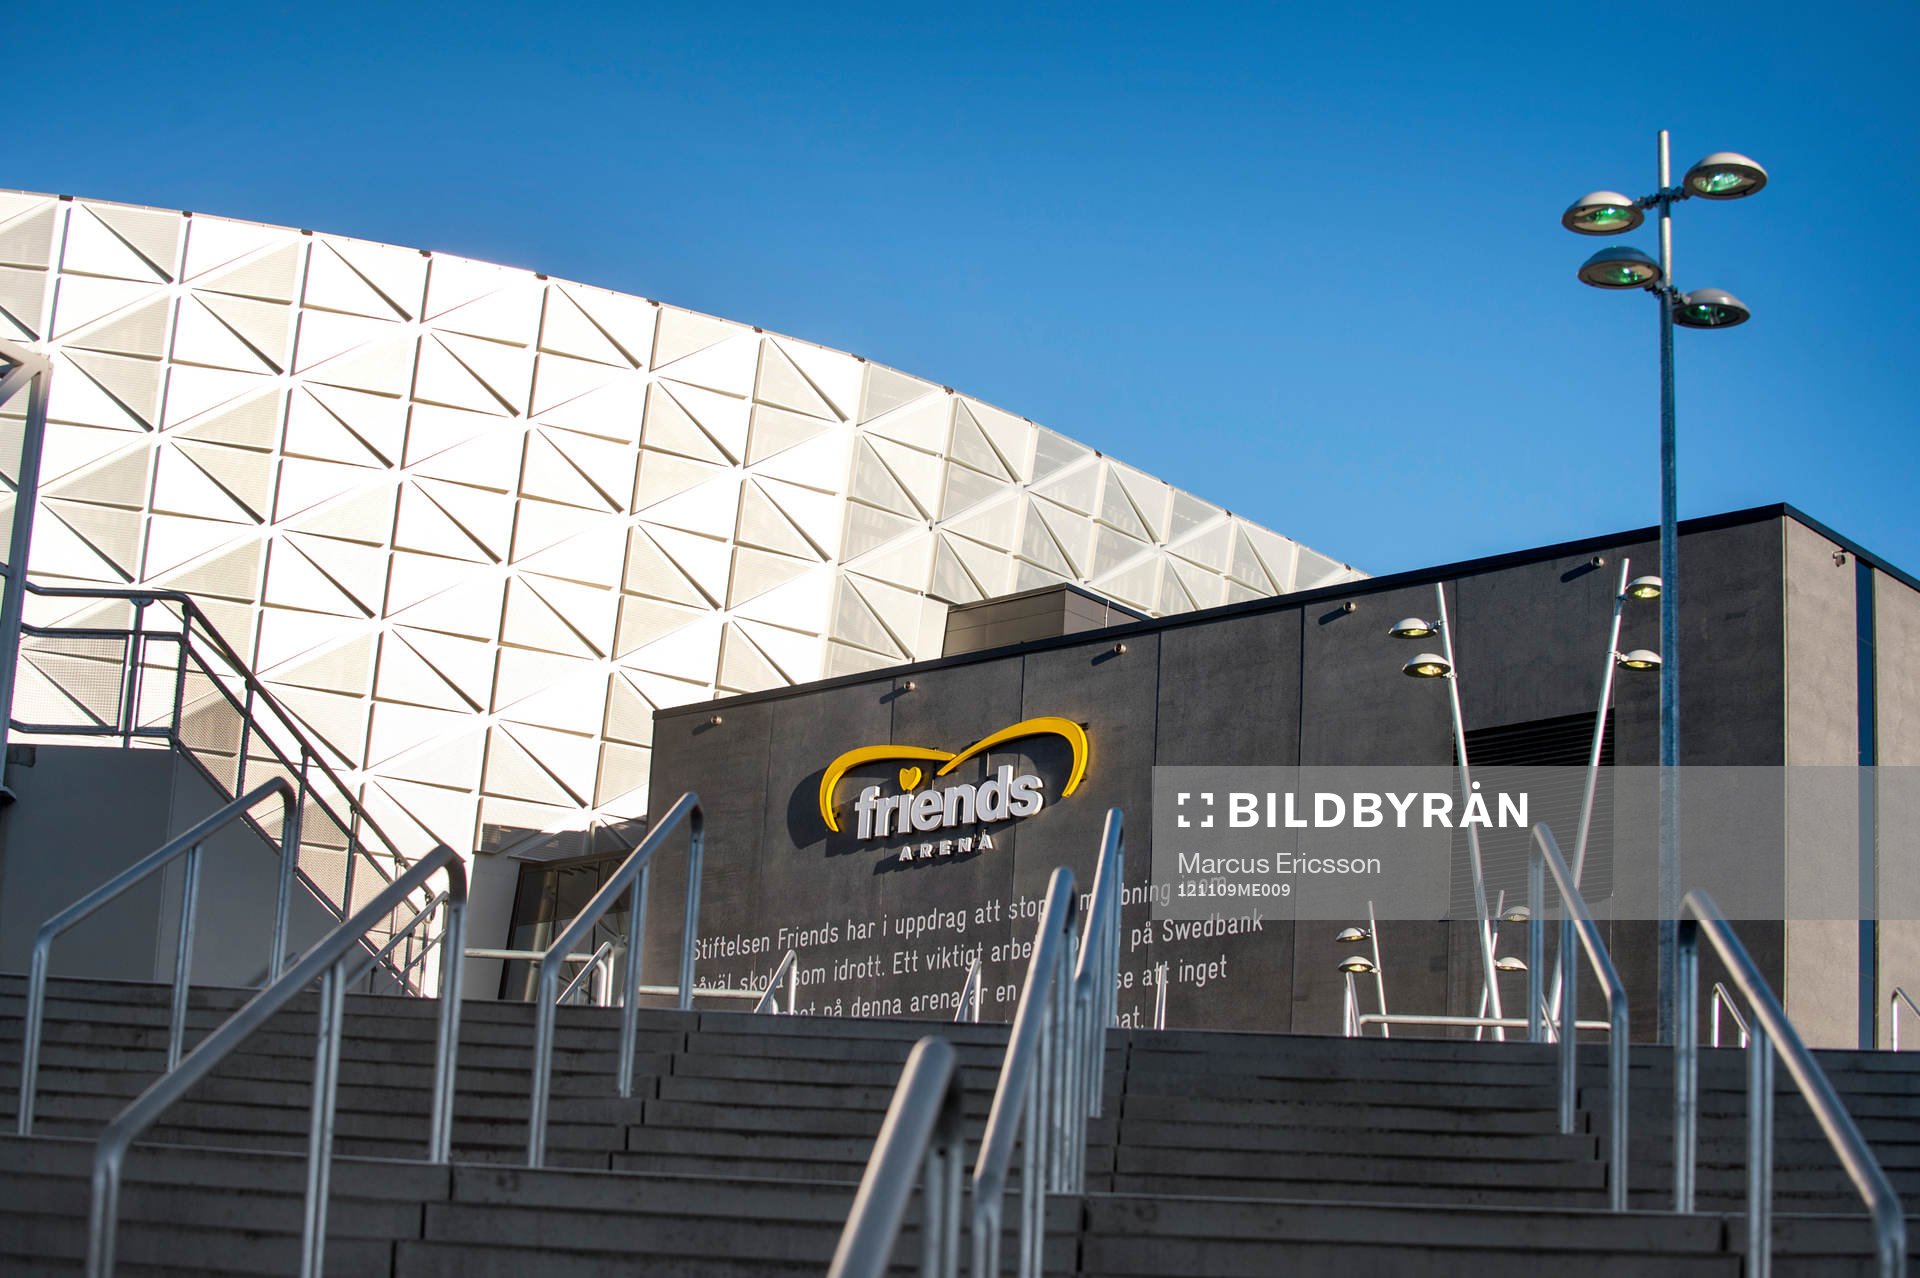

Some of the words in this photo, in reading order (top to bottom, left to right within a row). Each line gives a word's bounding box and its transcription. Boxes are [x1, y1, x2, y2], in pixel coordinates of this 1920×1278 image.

[854, 765, 1044, 840] friends
[899, 829, 994, 862] ARENA
[692, 973, 732, 991] åväl
[834, 954, 886, 981] idrott.
[893, 951, 918, 975] Ett
[926, 942, 982, 972] viktigt
[991, 936, 1039, 962] arbe
[1131, 921, 1153, 953] på
[1162, 907, 1264, 942] Swedbank
[694, 934, 770, 960] Stiftelsen
[778, 922, 839, 950] Friends
[847, 919, 875, 941] har
[882, 914, 888, 936] i
[895, 908, 967, 939] uppdrag
[975, 899, 1001, 924] att
[1008, 895, 1046, 922] stop
[851, 996, 902, 1018] denna
[910, 990, 960, 1012] arena
[996, 984, 1017, 1002] en
[1179, 954, 1227, 988] inget
